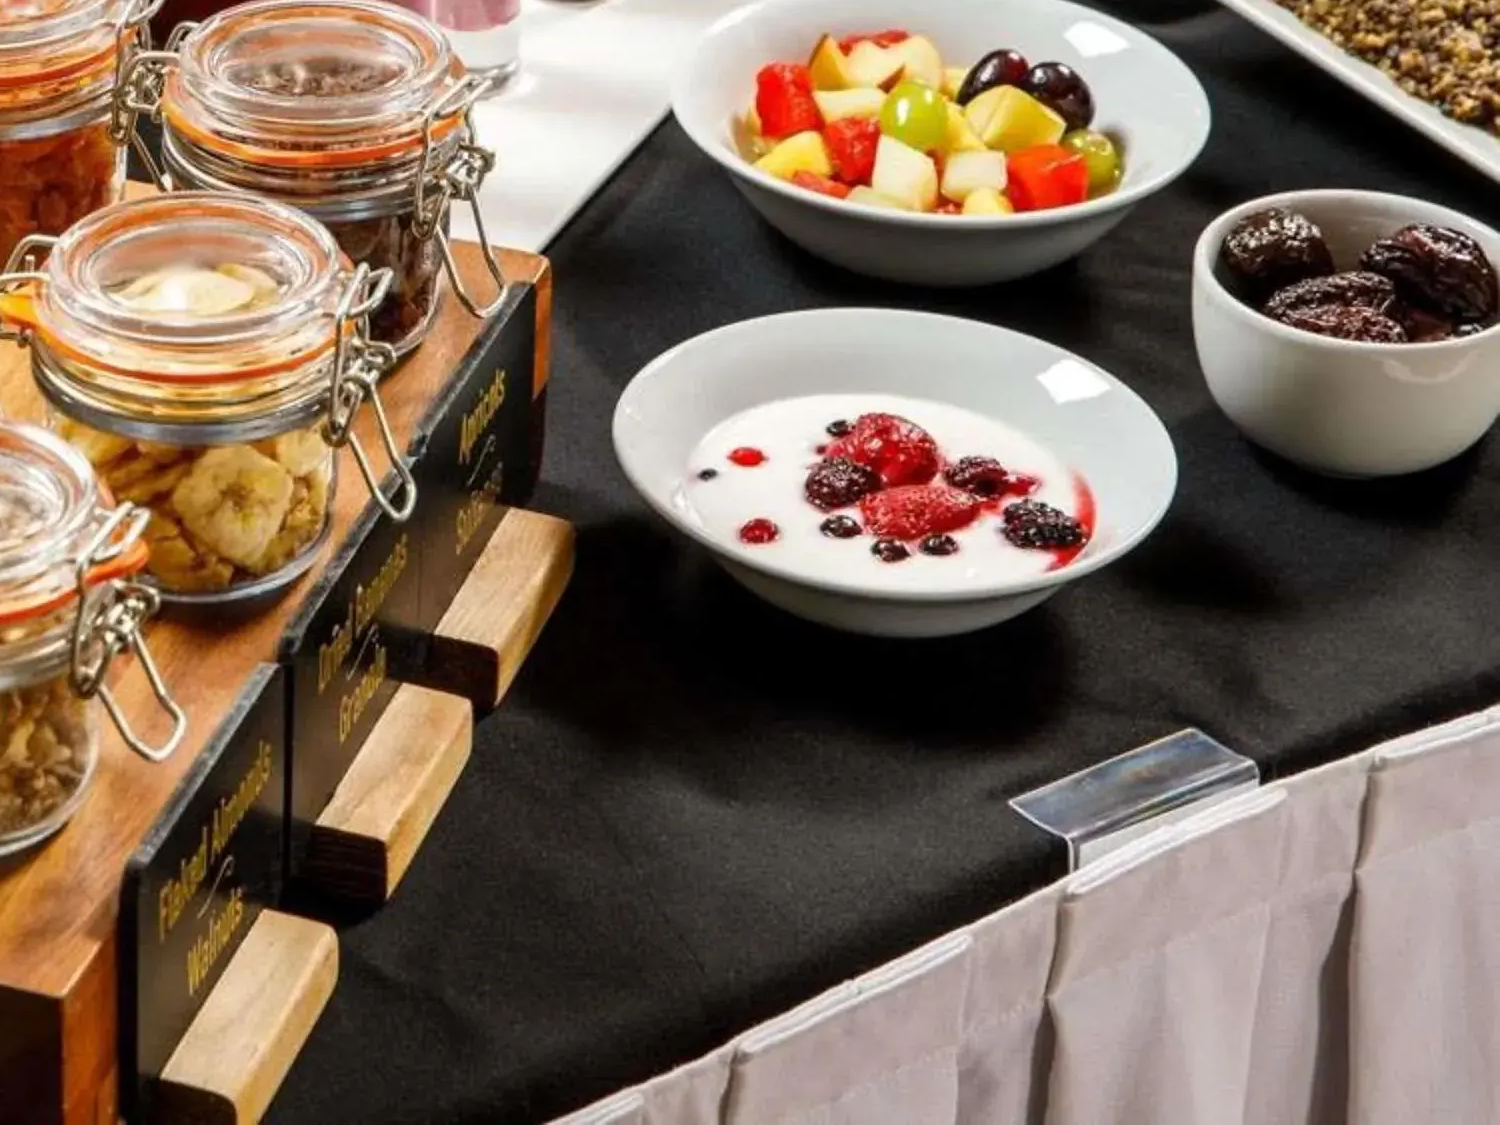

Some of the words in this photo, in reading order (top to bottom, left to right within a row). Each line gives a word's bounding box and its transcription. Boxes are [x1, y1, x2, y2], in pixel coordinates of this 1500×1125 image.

[159, 826, 208, 945] Flaked
[211, 739, 274, 865] Almonds
[187, 886, 244, 997] Walnuts
